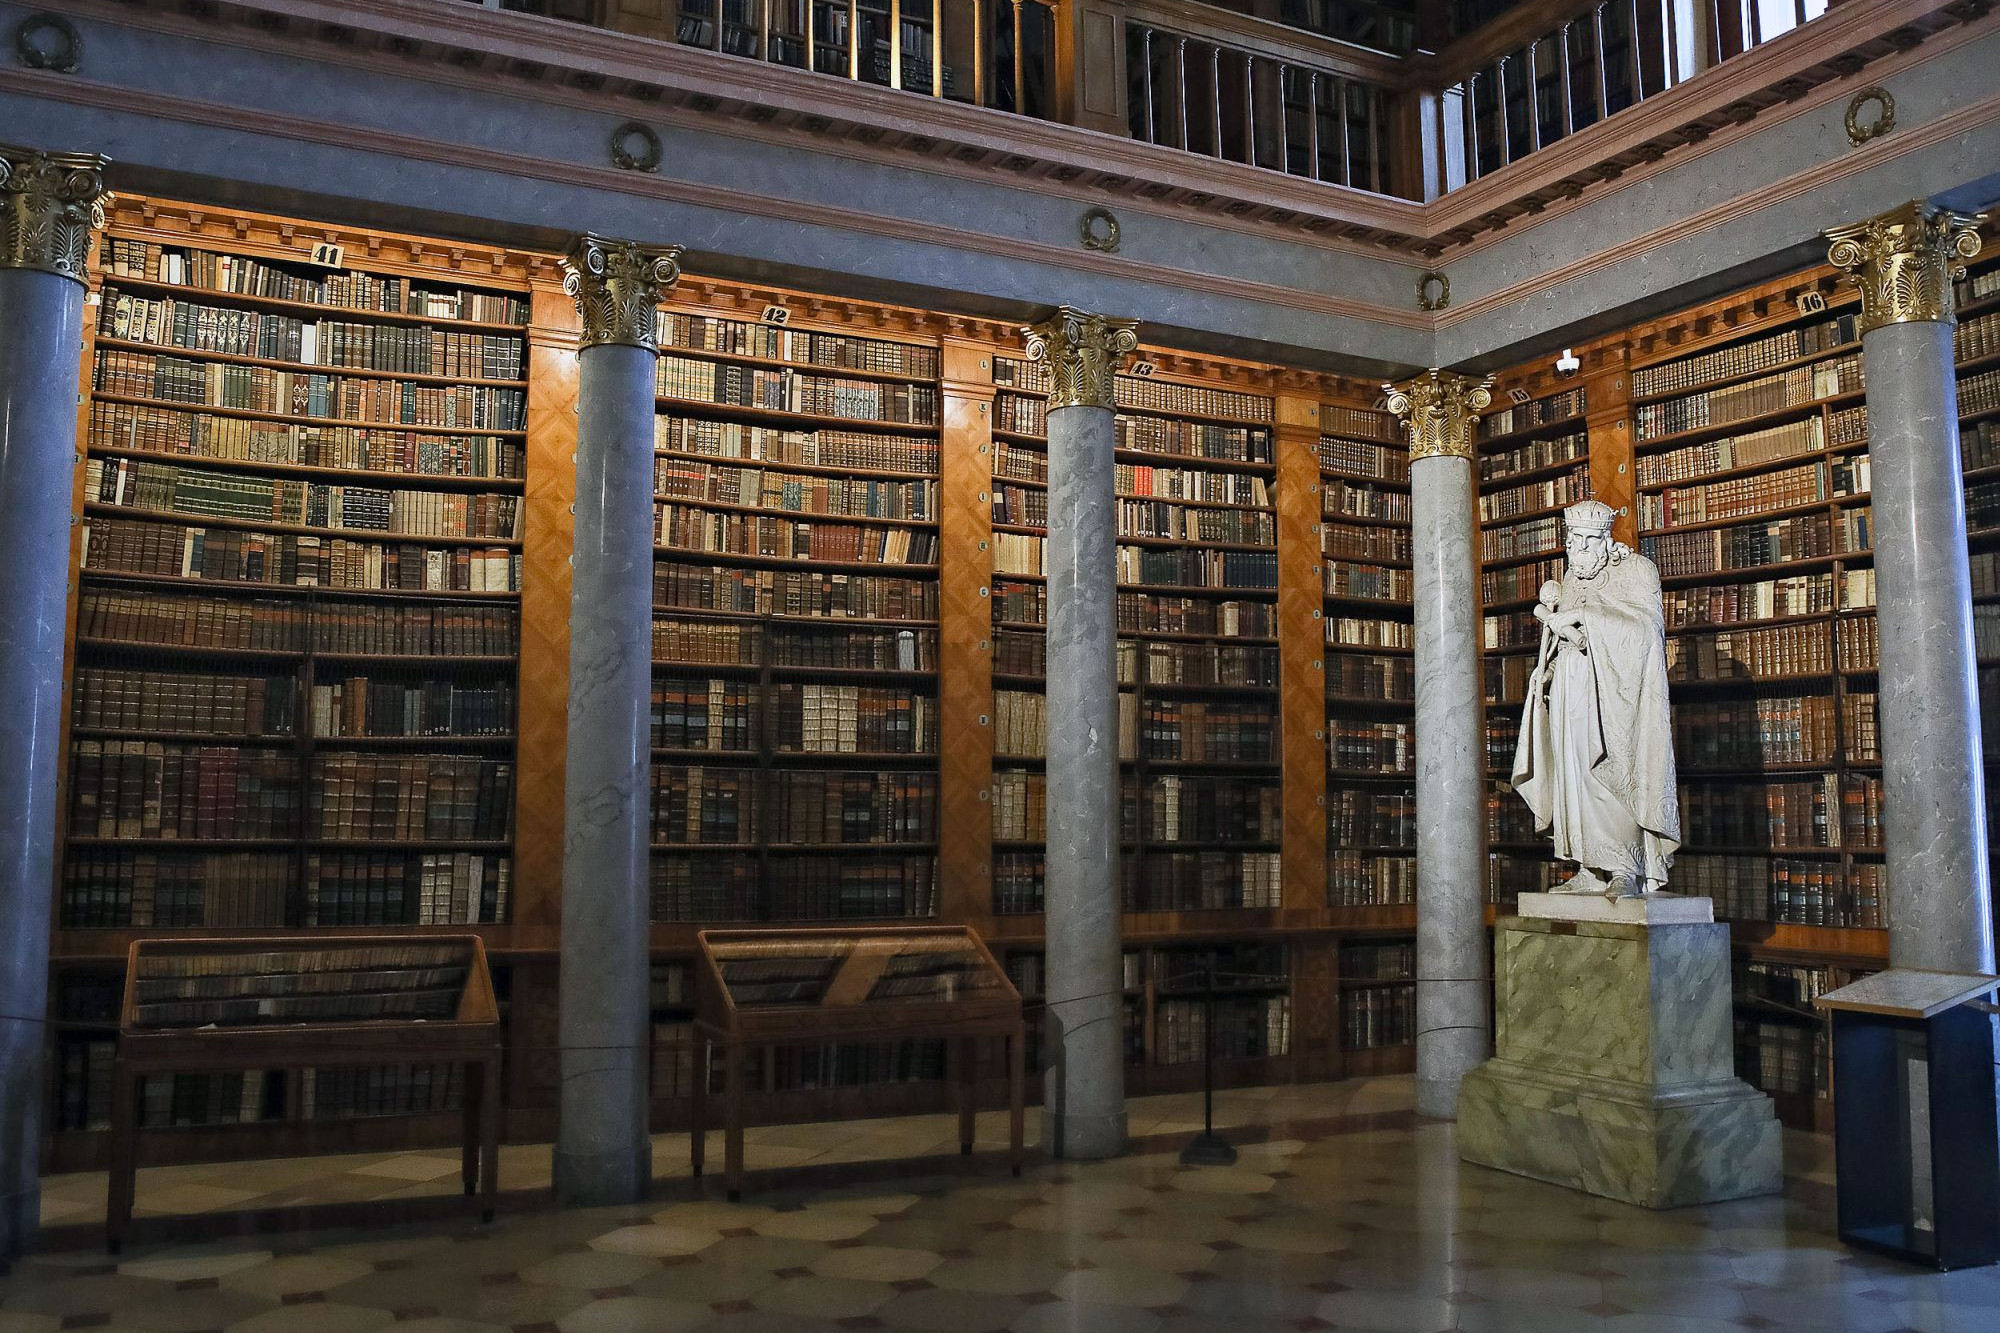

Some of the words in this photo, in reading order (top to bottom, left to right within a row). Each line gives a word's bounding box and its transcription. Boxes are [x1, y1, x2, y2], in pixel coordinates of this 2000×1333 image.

[314, 246, 338, 265] 41
[1801, 294, 1822, 312] 46
[763, 308, 787, 323] 42
[1133, 364, 1153, 376] 43
